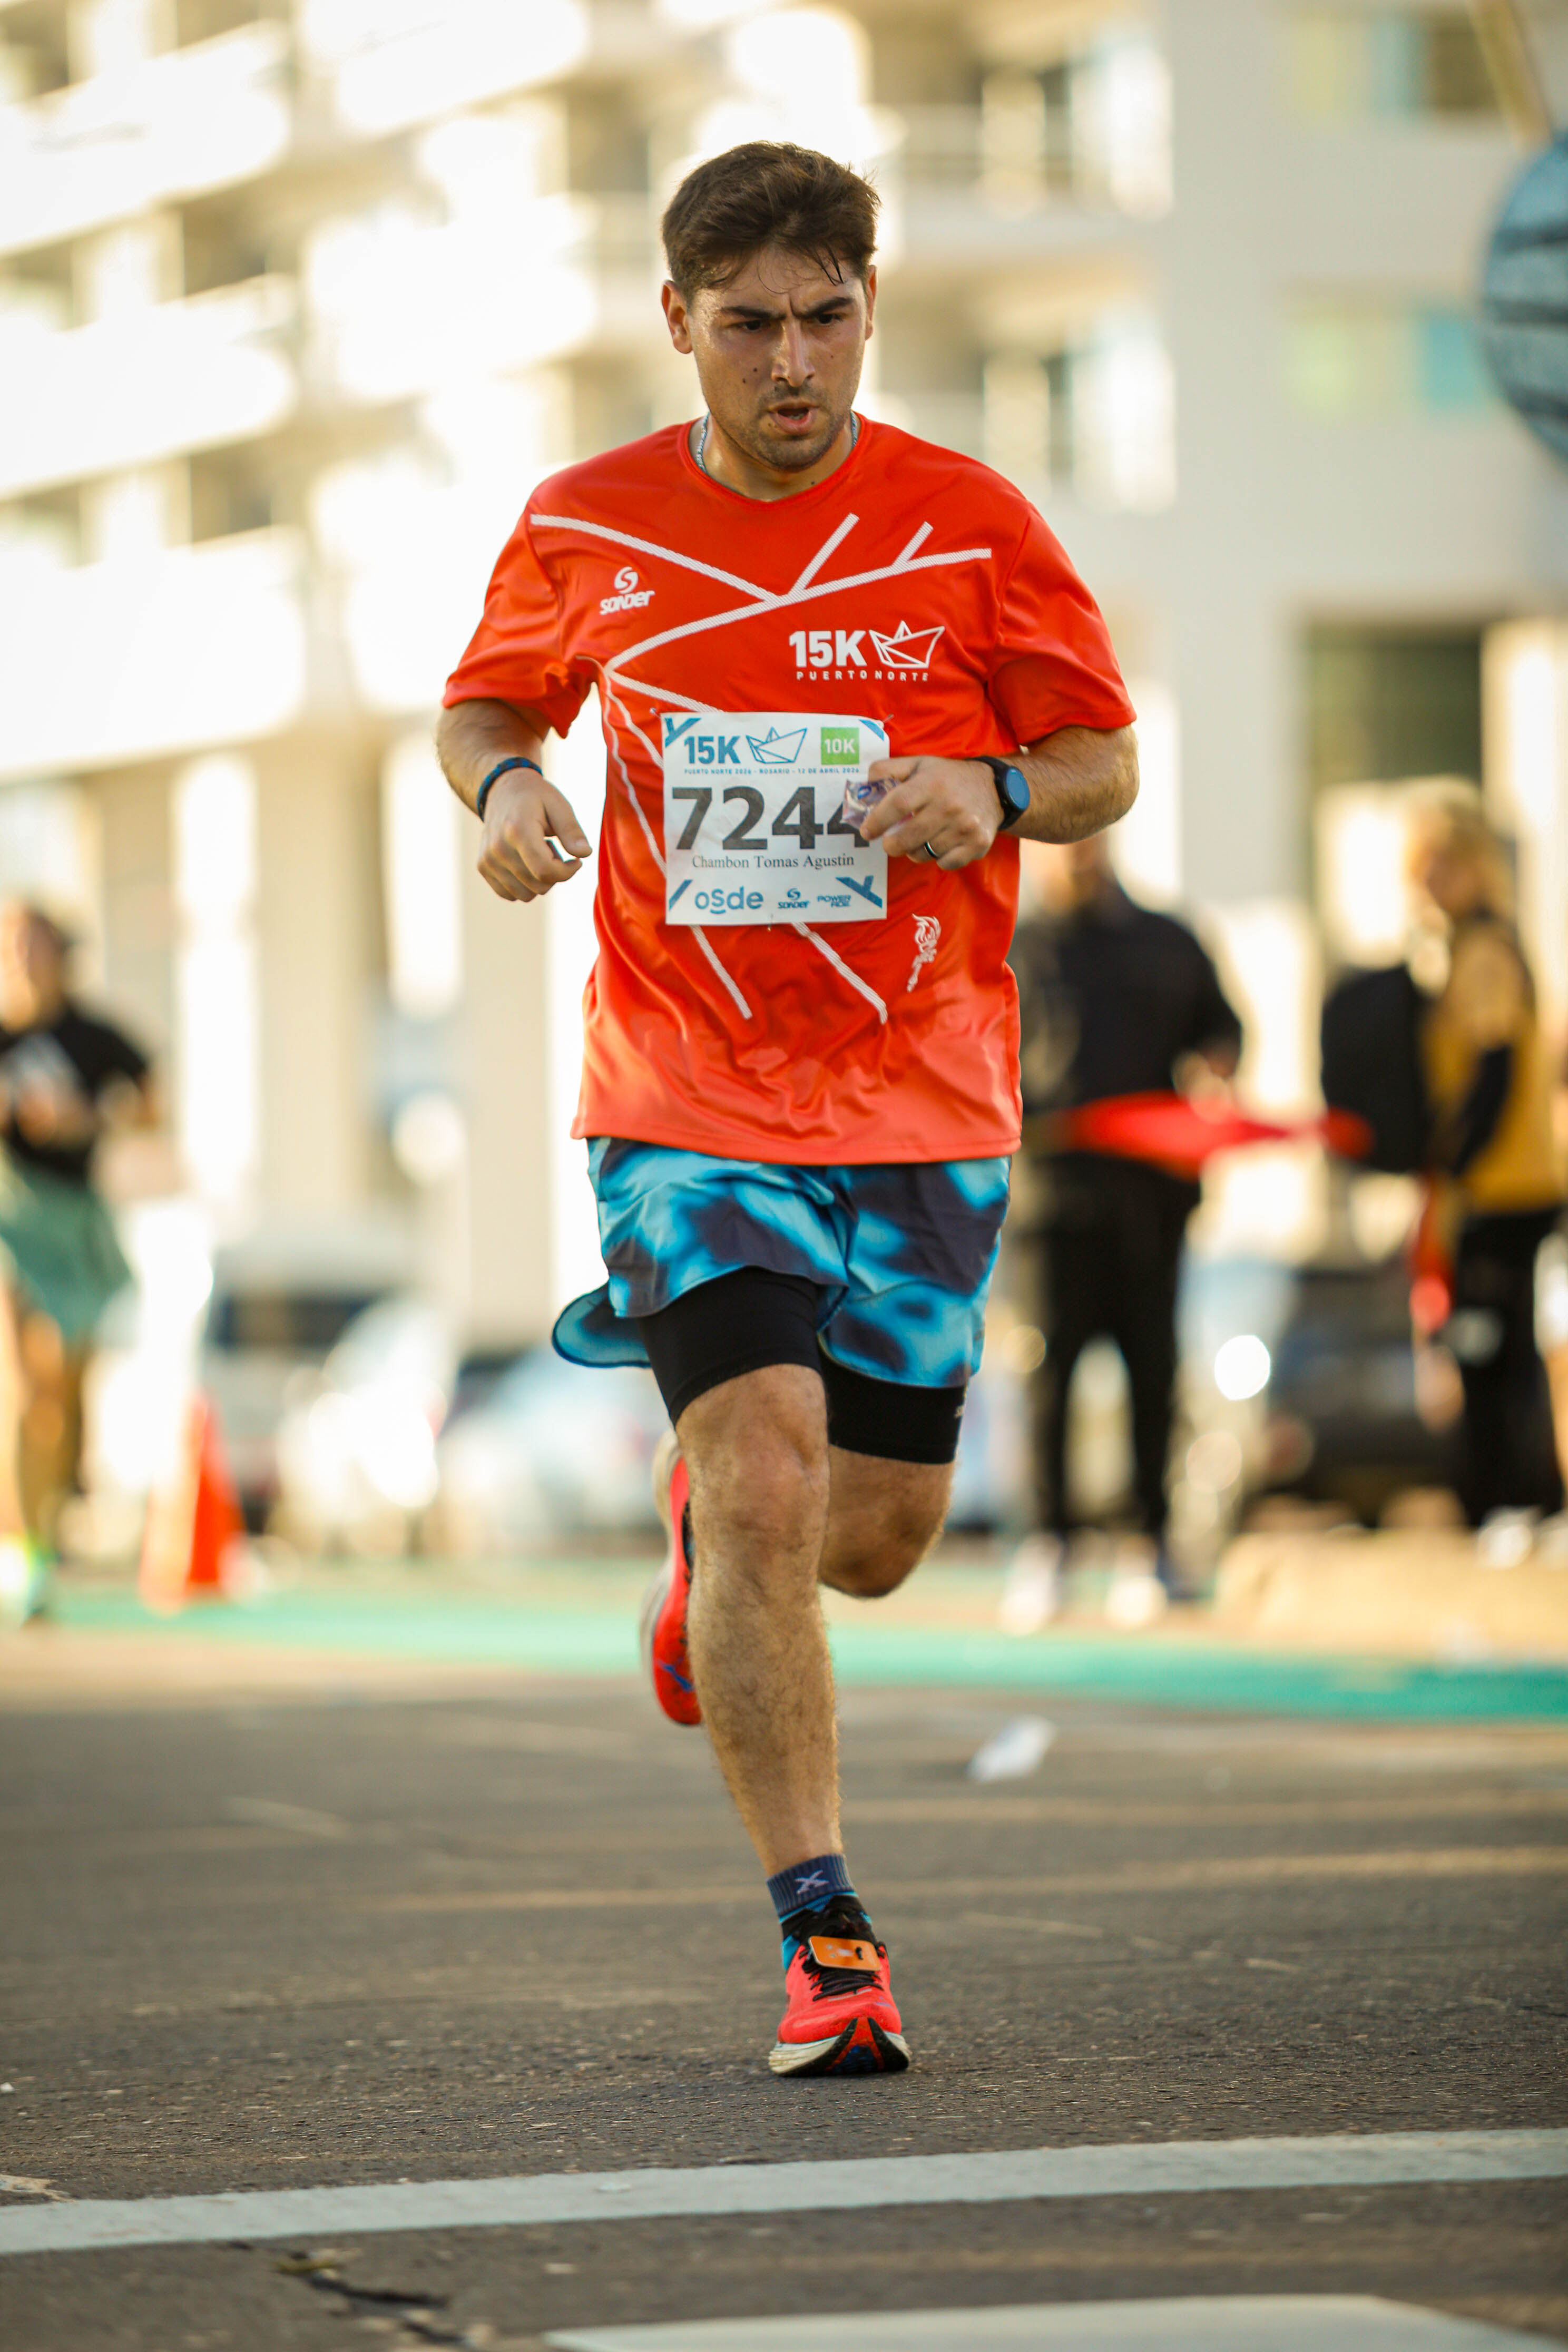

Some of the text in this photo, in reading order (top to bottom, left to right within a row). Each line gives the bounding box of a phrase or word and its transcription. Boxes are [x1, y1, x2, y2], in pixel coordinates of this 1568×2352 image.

[789, 630, 867, 667] 15K
[797, 670, 929, 681] PUERTO NORTE
[684, 736, 741, 764] 15K
[825, 739, 855, 754] 10K
[692, 855, 749, 868] Chambon
[754, 855, 799, 868] Tomas
[695, 886, 764, 909] osde
